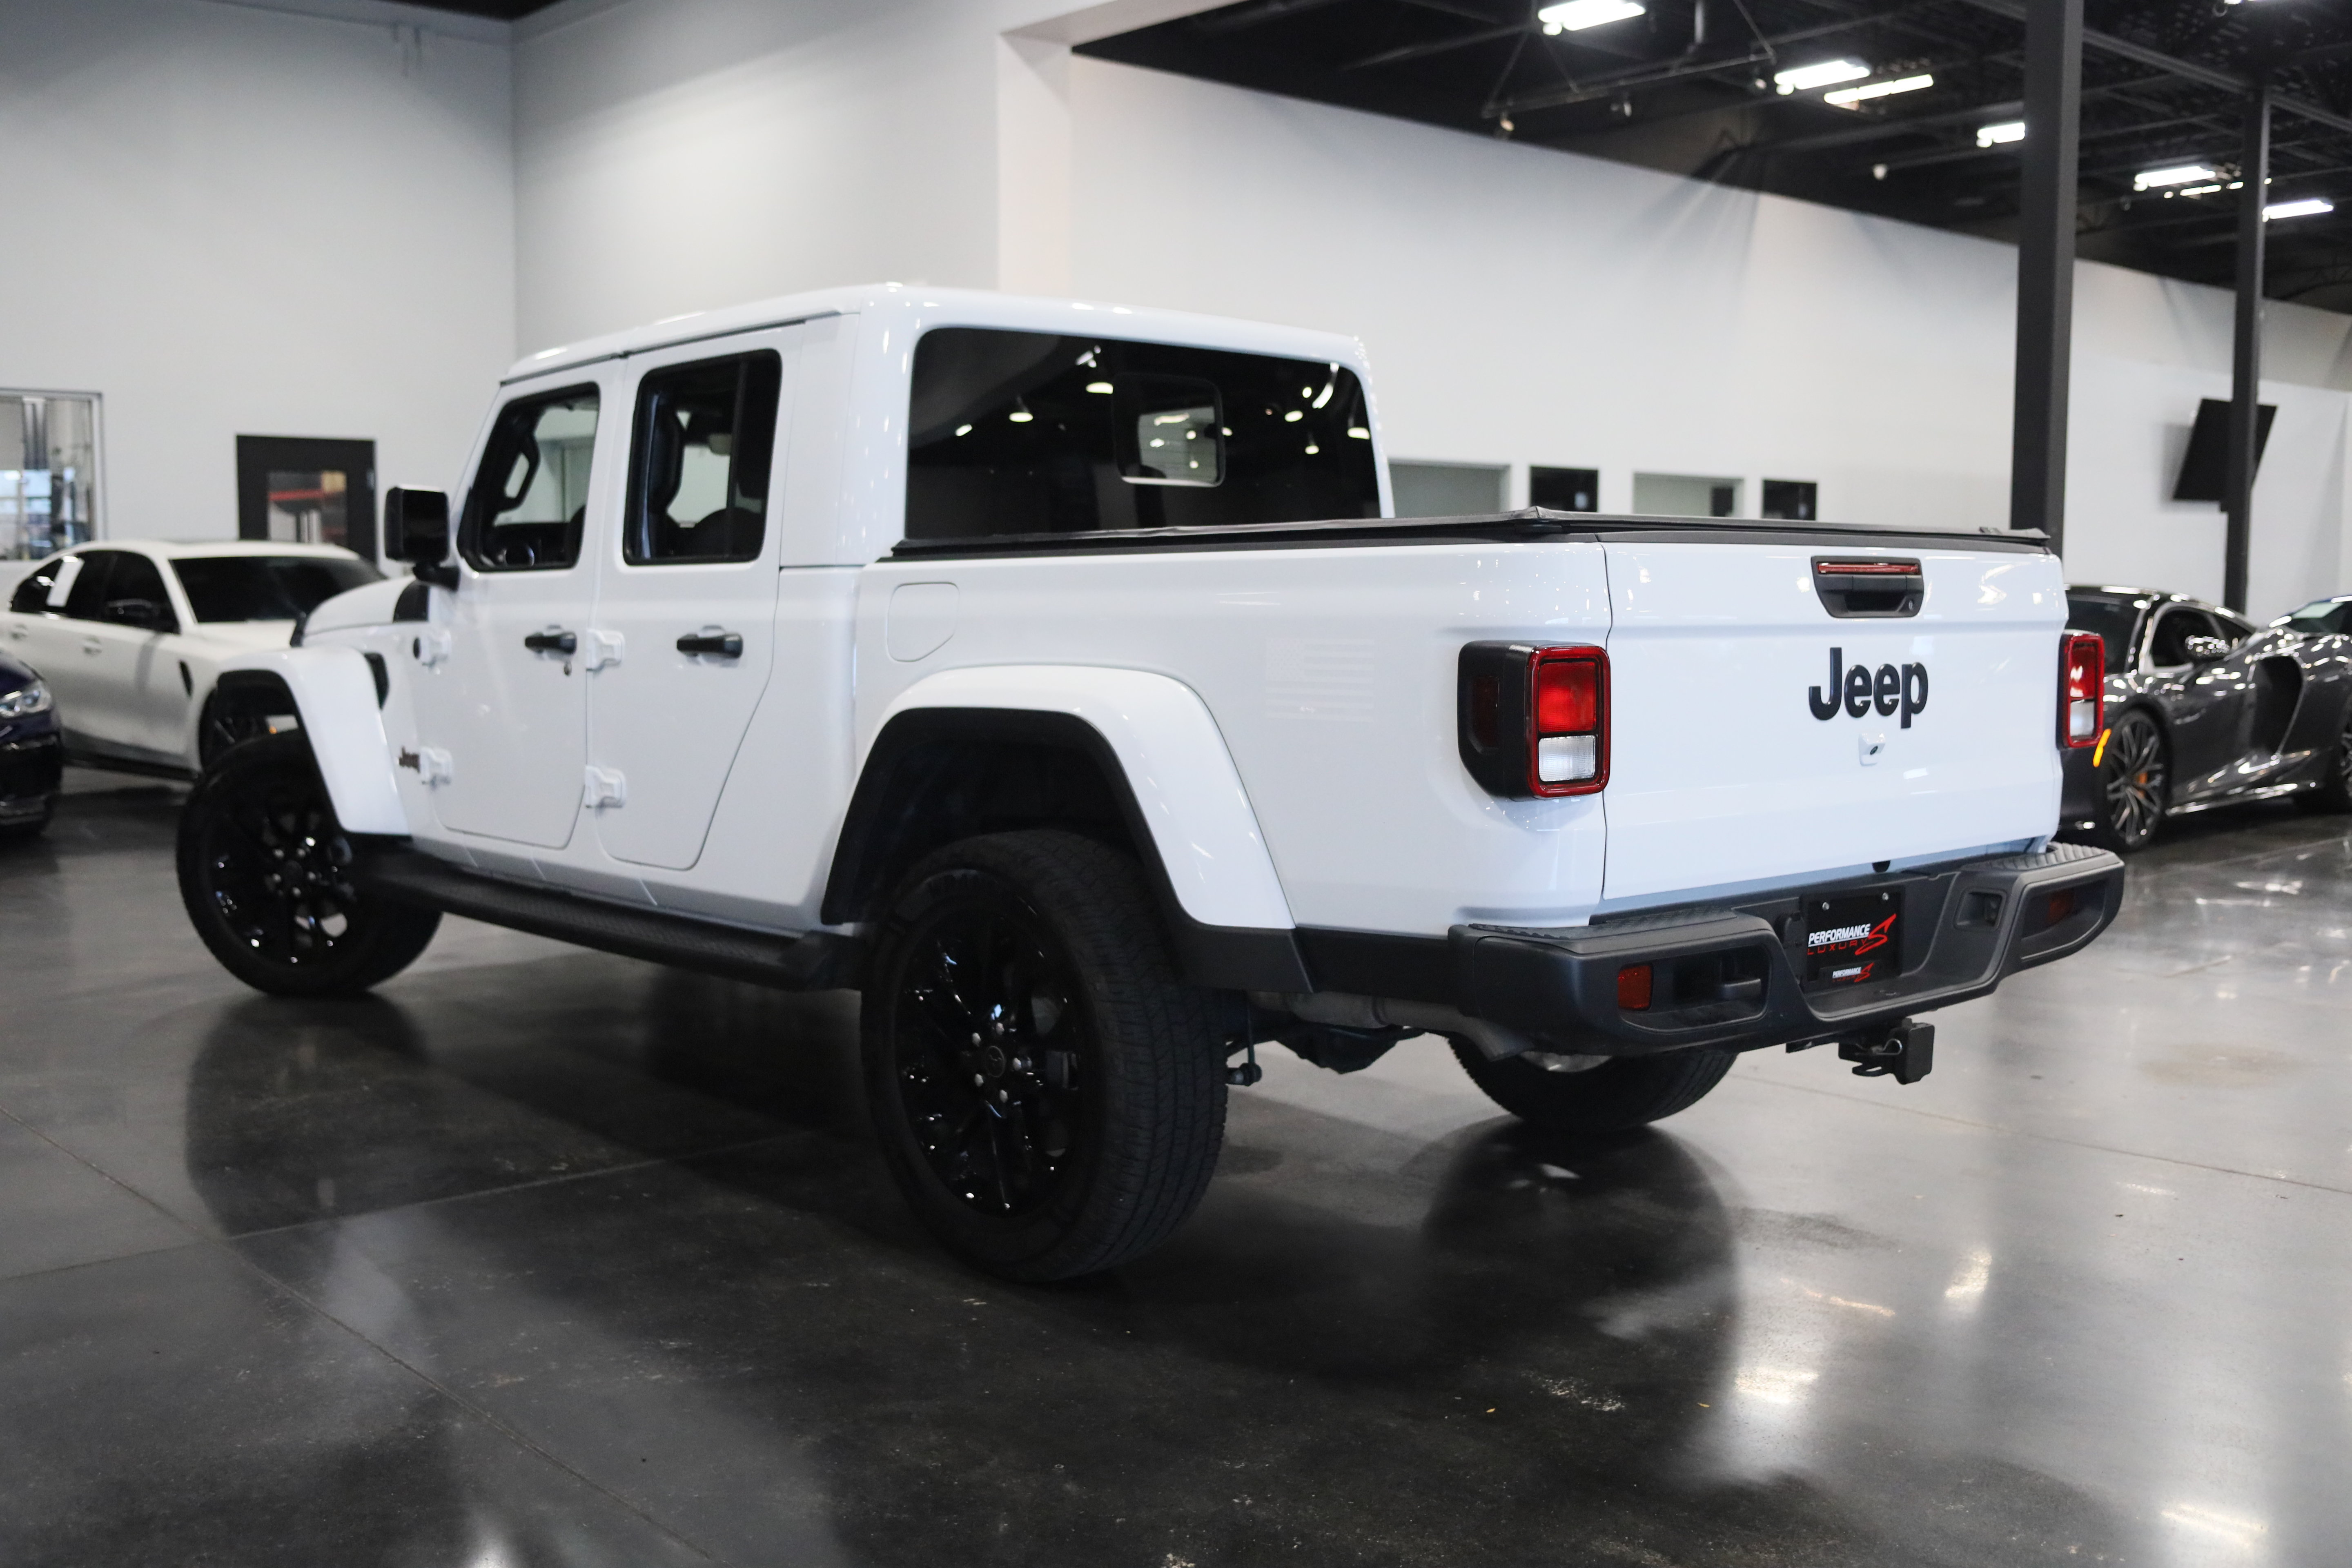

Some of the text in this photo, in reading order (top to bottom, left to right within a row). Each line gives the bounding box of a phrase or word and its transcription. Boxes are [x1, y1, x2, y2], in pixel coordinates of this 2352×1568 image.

[1809, 647, 1928, 729] Jeep
[1808, 923, 1871, 945] PERFORMANCE
[1807, 938, 1868, 956] LUXURY
[1832, 967, 1862, 978] PERFORMANCE
